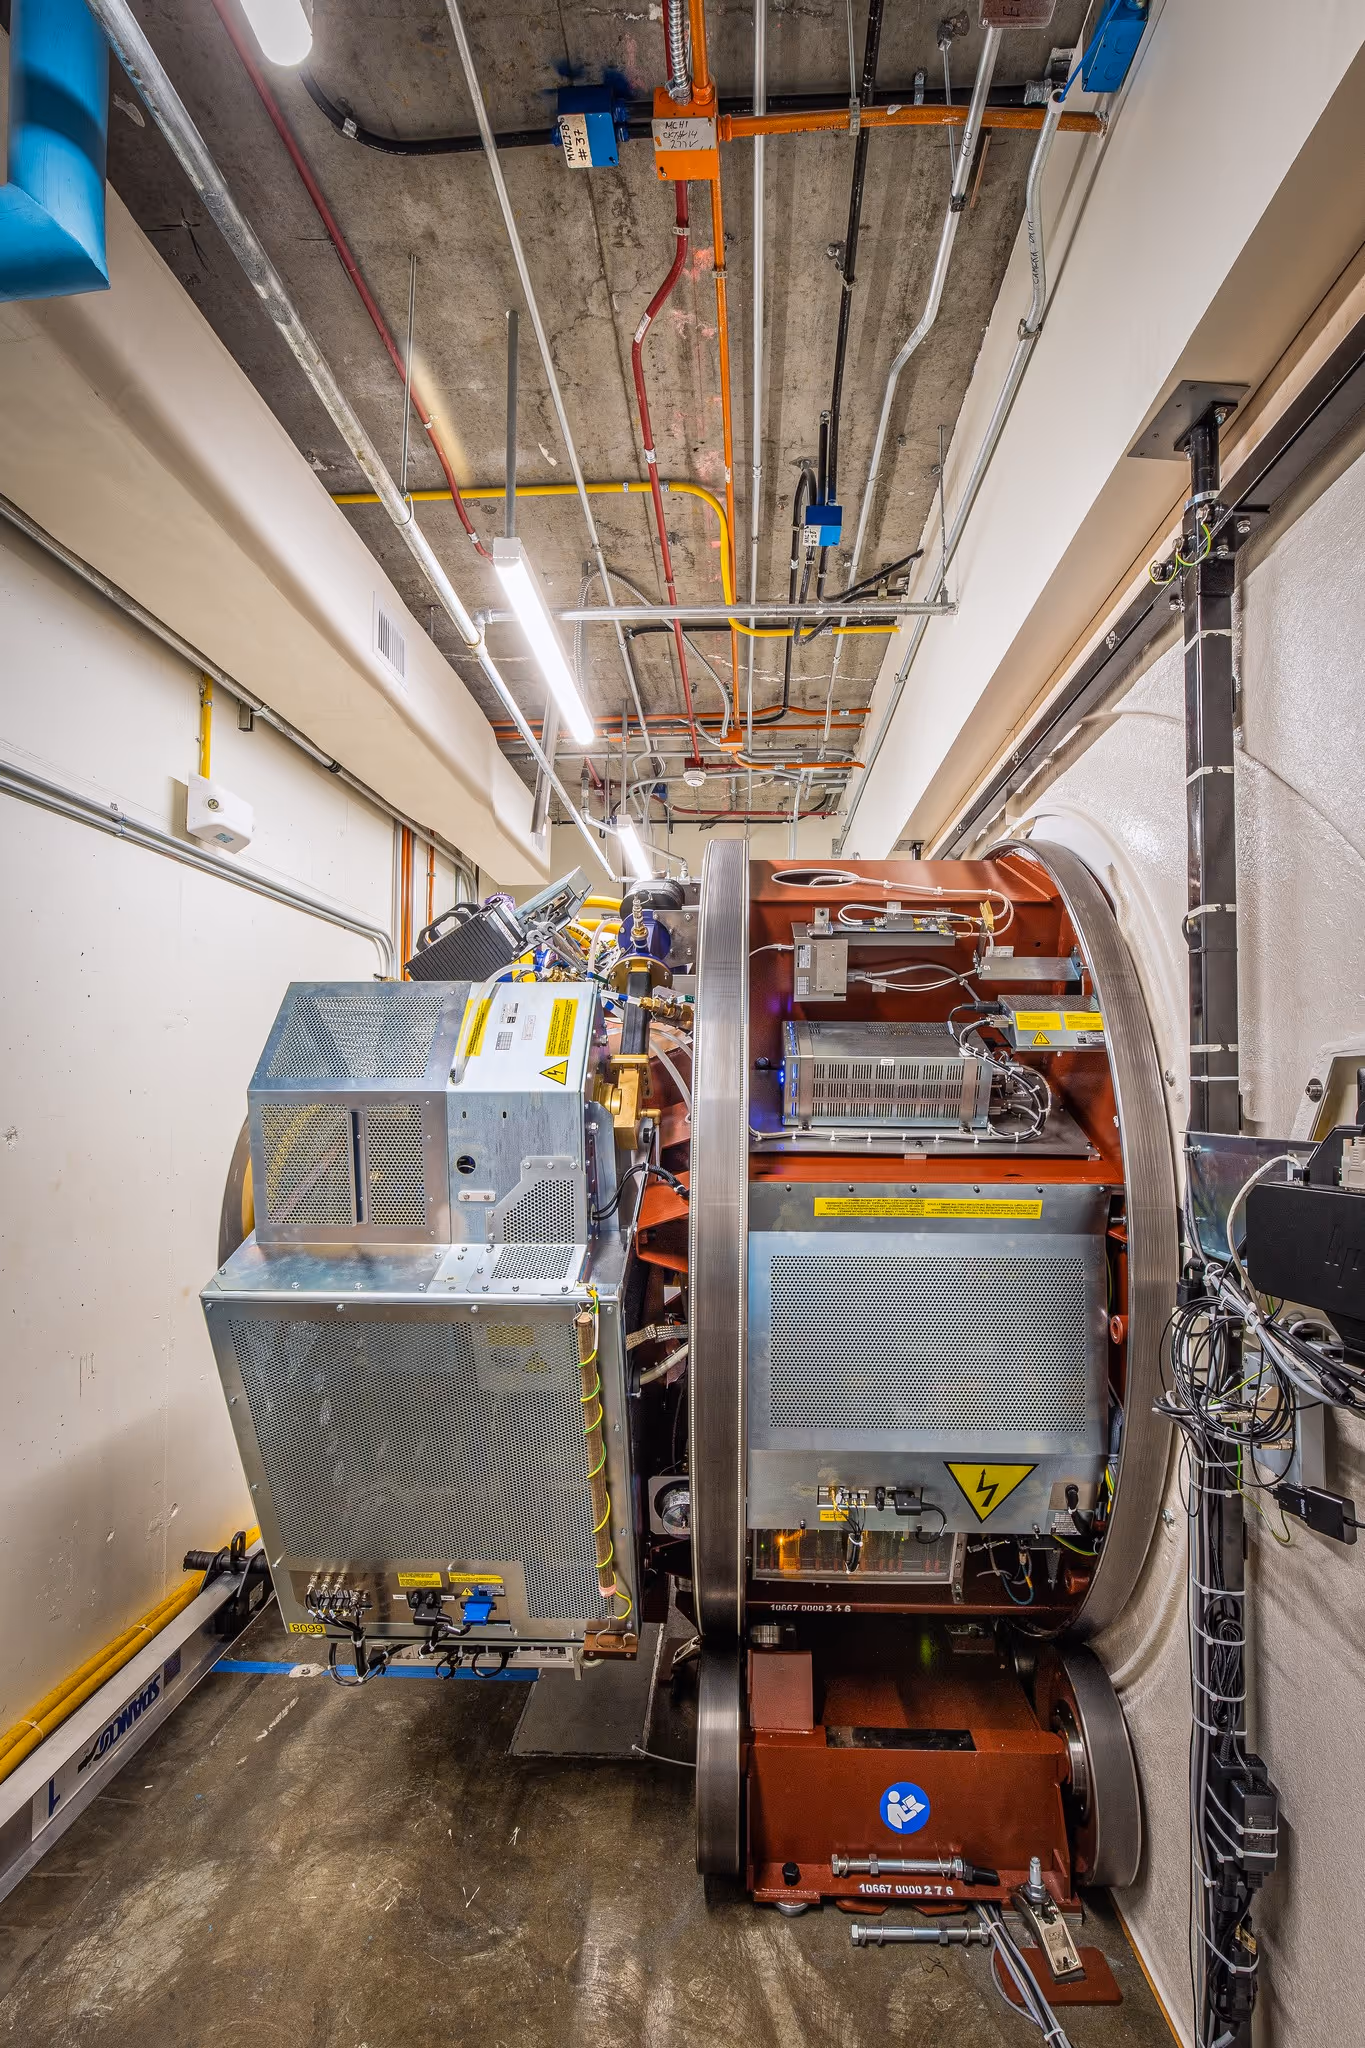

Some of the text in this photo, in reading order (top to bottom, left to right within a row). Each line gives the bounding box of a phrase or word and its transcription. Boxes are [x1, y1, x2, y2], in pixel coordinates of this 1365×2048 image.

[770, 1603, 798, 1612] 10667
[292, 1623, 323, 1633] 8099
[93, 1674, 161, 1762] SPANCO
[859, 1883, 892, 1893] 10667
